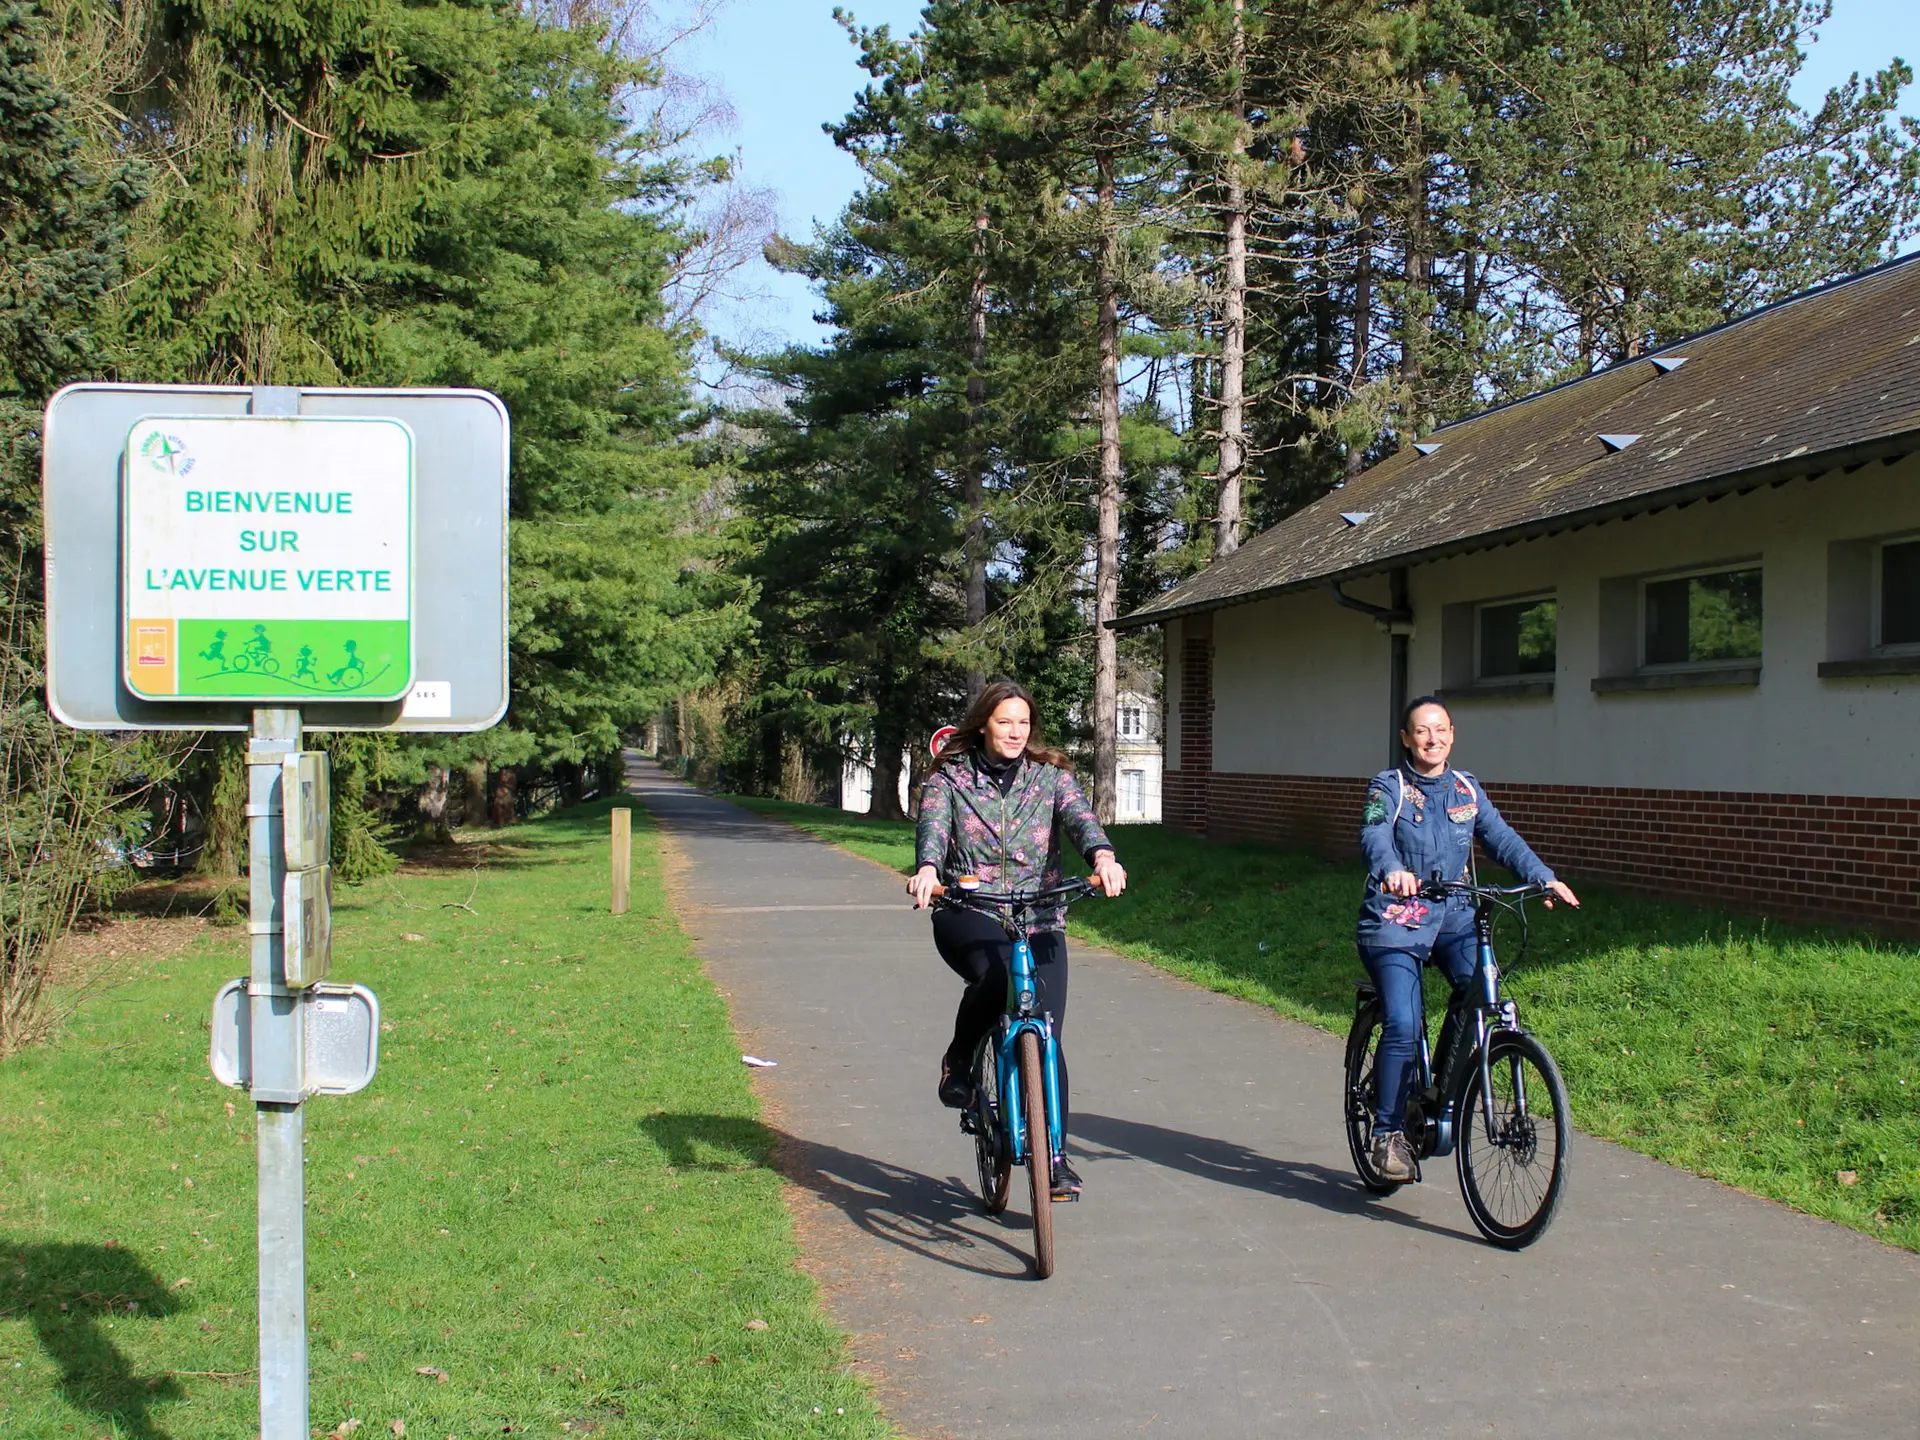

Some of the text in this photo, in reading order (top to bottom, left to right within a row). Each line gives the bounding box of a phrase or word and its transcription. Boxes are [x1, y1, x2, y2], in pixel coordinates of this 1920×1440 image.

[179, 458, 196, 478] PARIS
[186, 491, 352, 513] BIENVENUE
[239, 530, 299, 552] SUR
[146, 568, 391, 591] L'AVENUE VERTE
